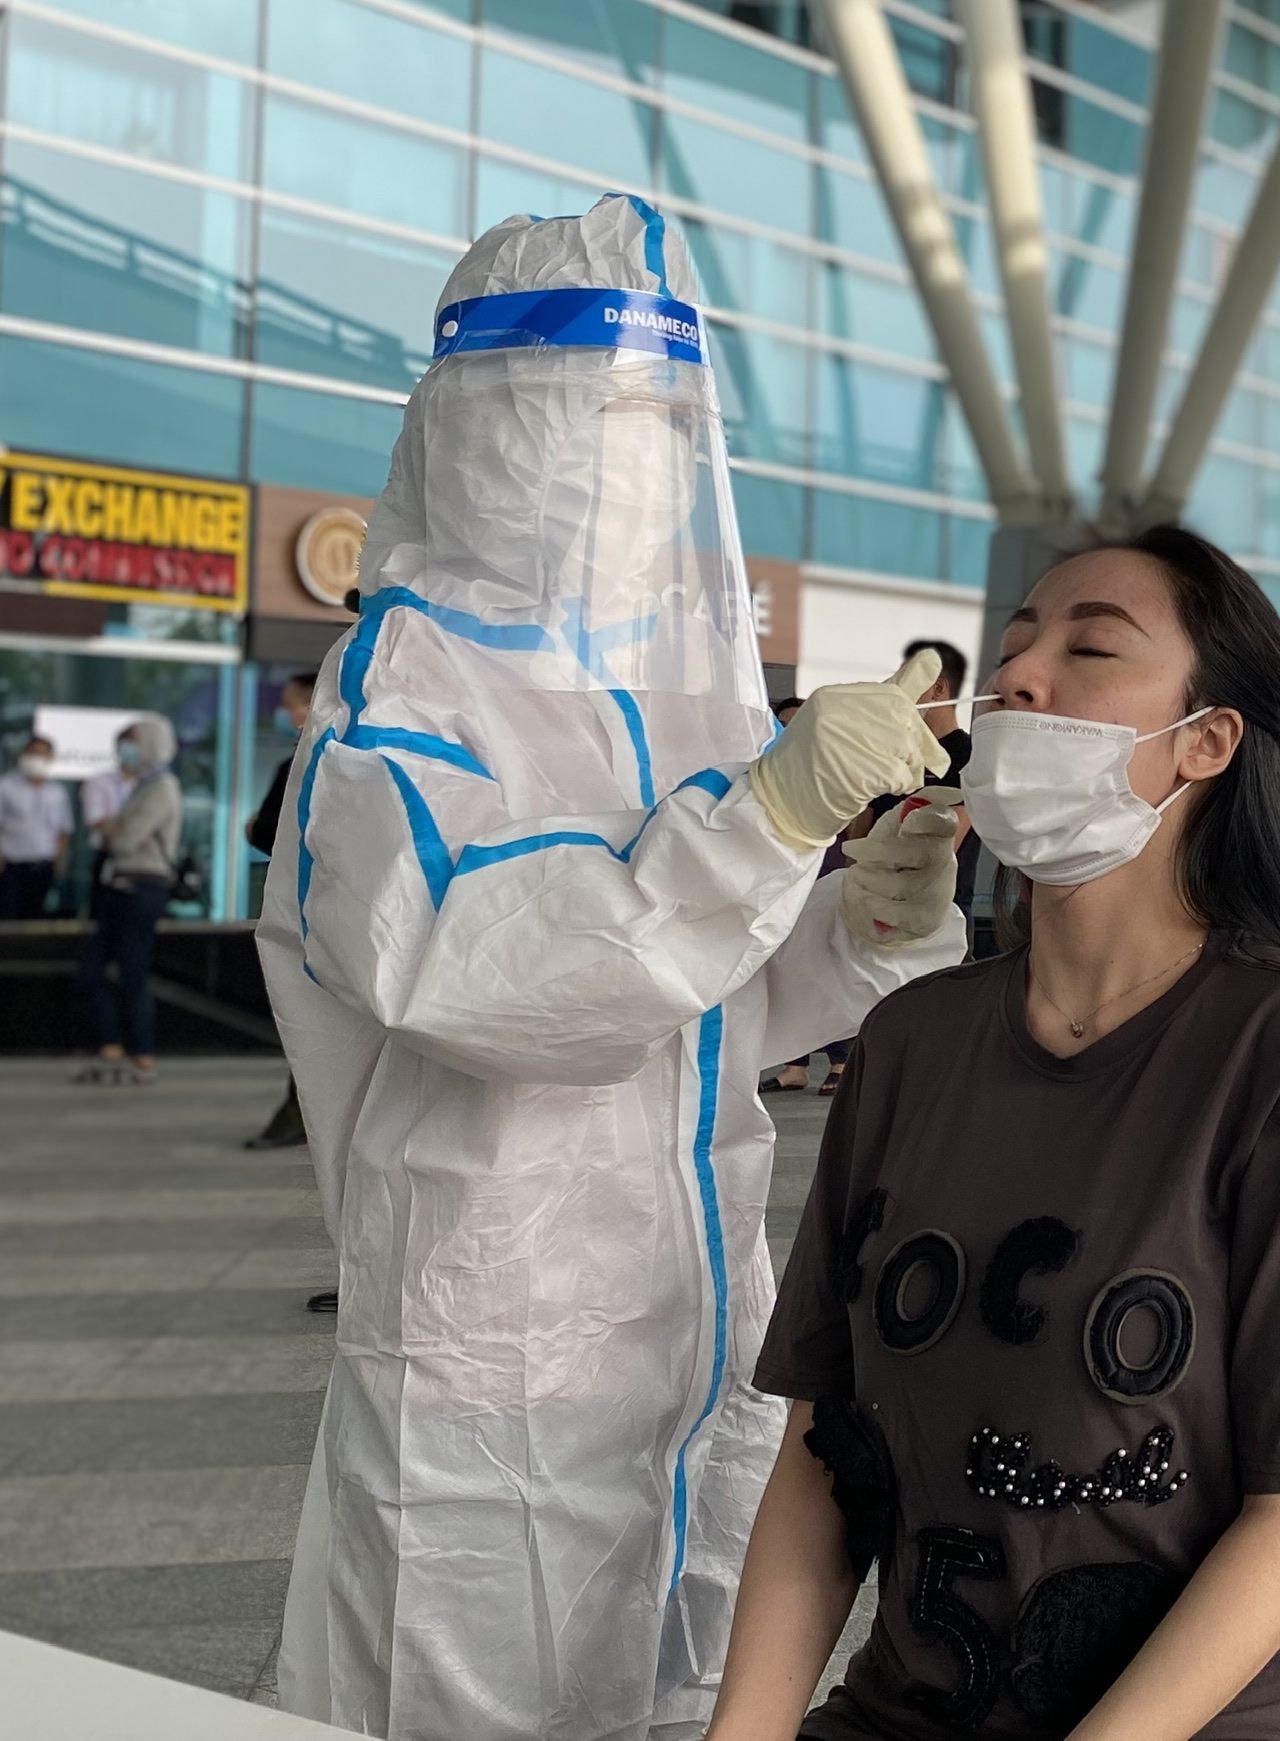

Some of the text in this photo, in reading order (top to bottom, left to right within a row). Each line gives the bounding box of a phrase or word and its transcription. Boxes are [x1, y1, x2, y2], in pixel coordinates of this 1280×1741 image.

[604, 307, 698, 341] DANAMECO
[10, 472, 243, 550] EXCHANGE
[1038, 721, 1103, 738] WAKAMONO
